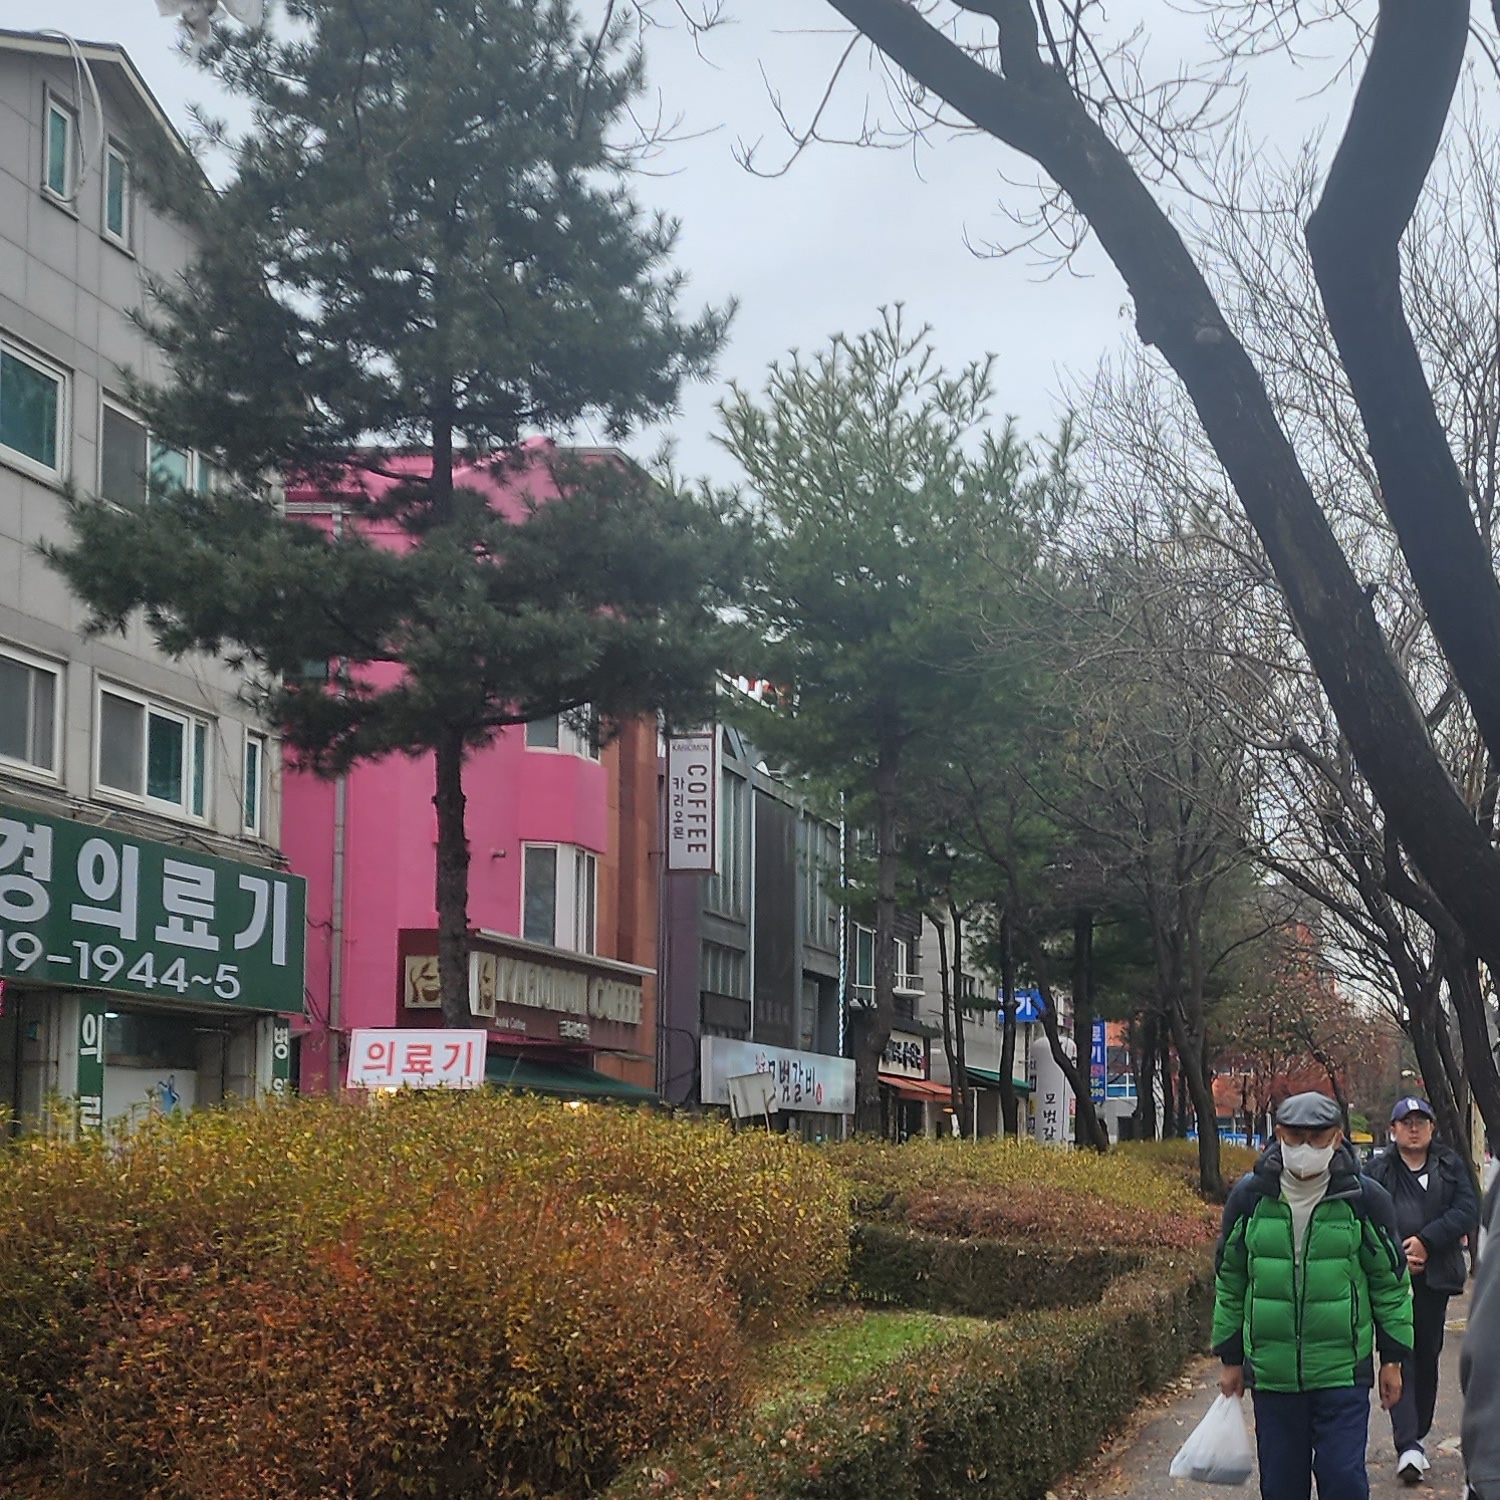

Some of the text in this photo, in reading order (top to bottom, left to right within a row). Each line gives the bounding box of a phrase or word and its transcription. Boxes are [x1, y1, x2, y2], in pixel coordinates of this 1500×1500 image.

[672, 777, 685, 840] 카리오몬
[687, 764, 707, 853] COFFEE
[362, 1041, 473, 1077] 의료기
